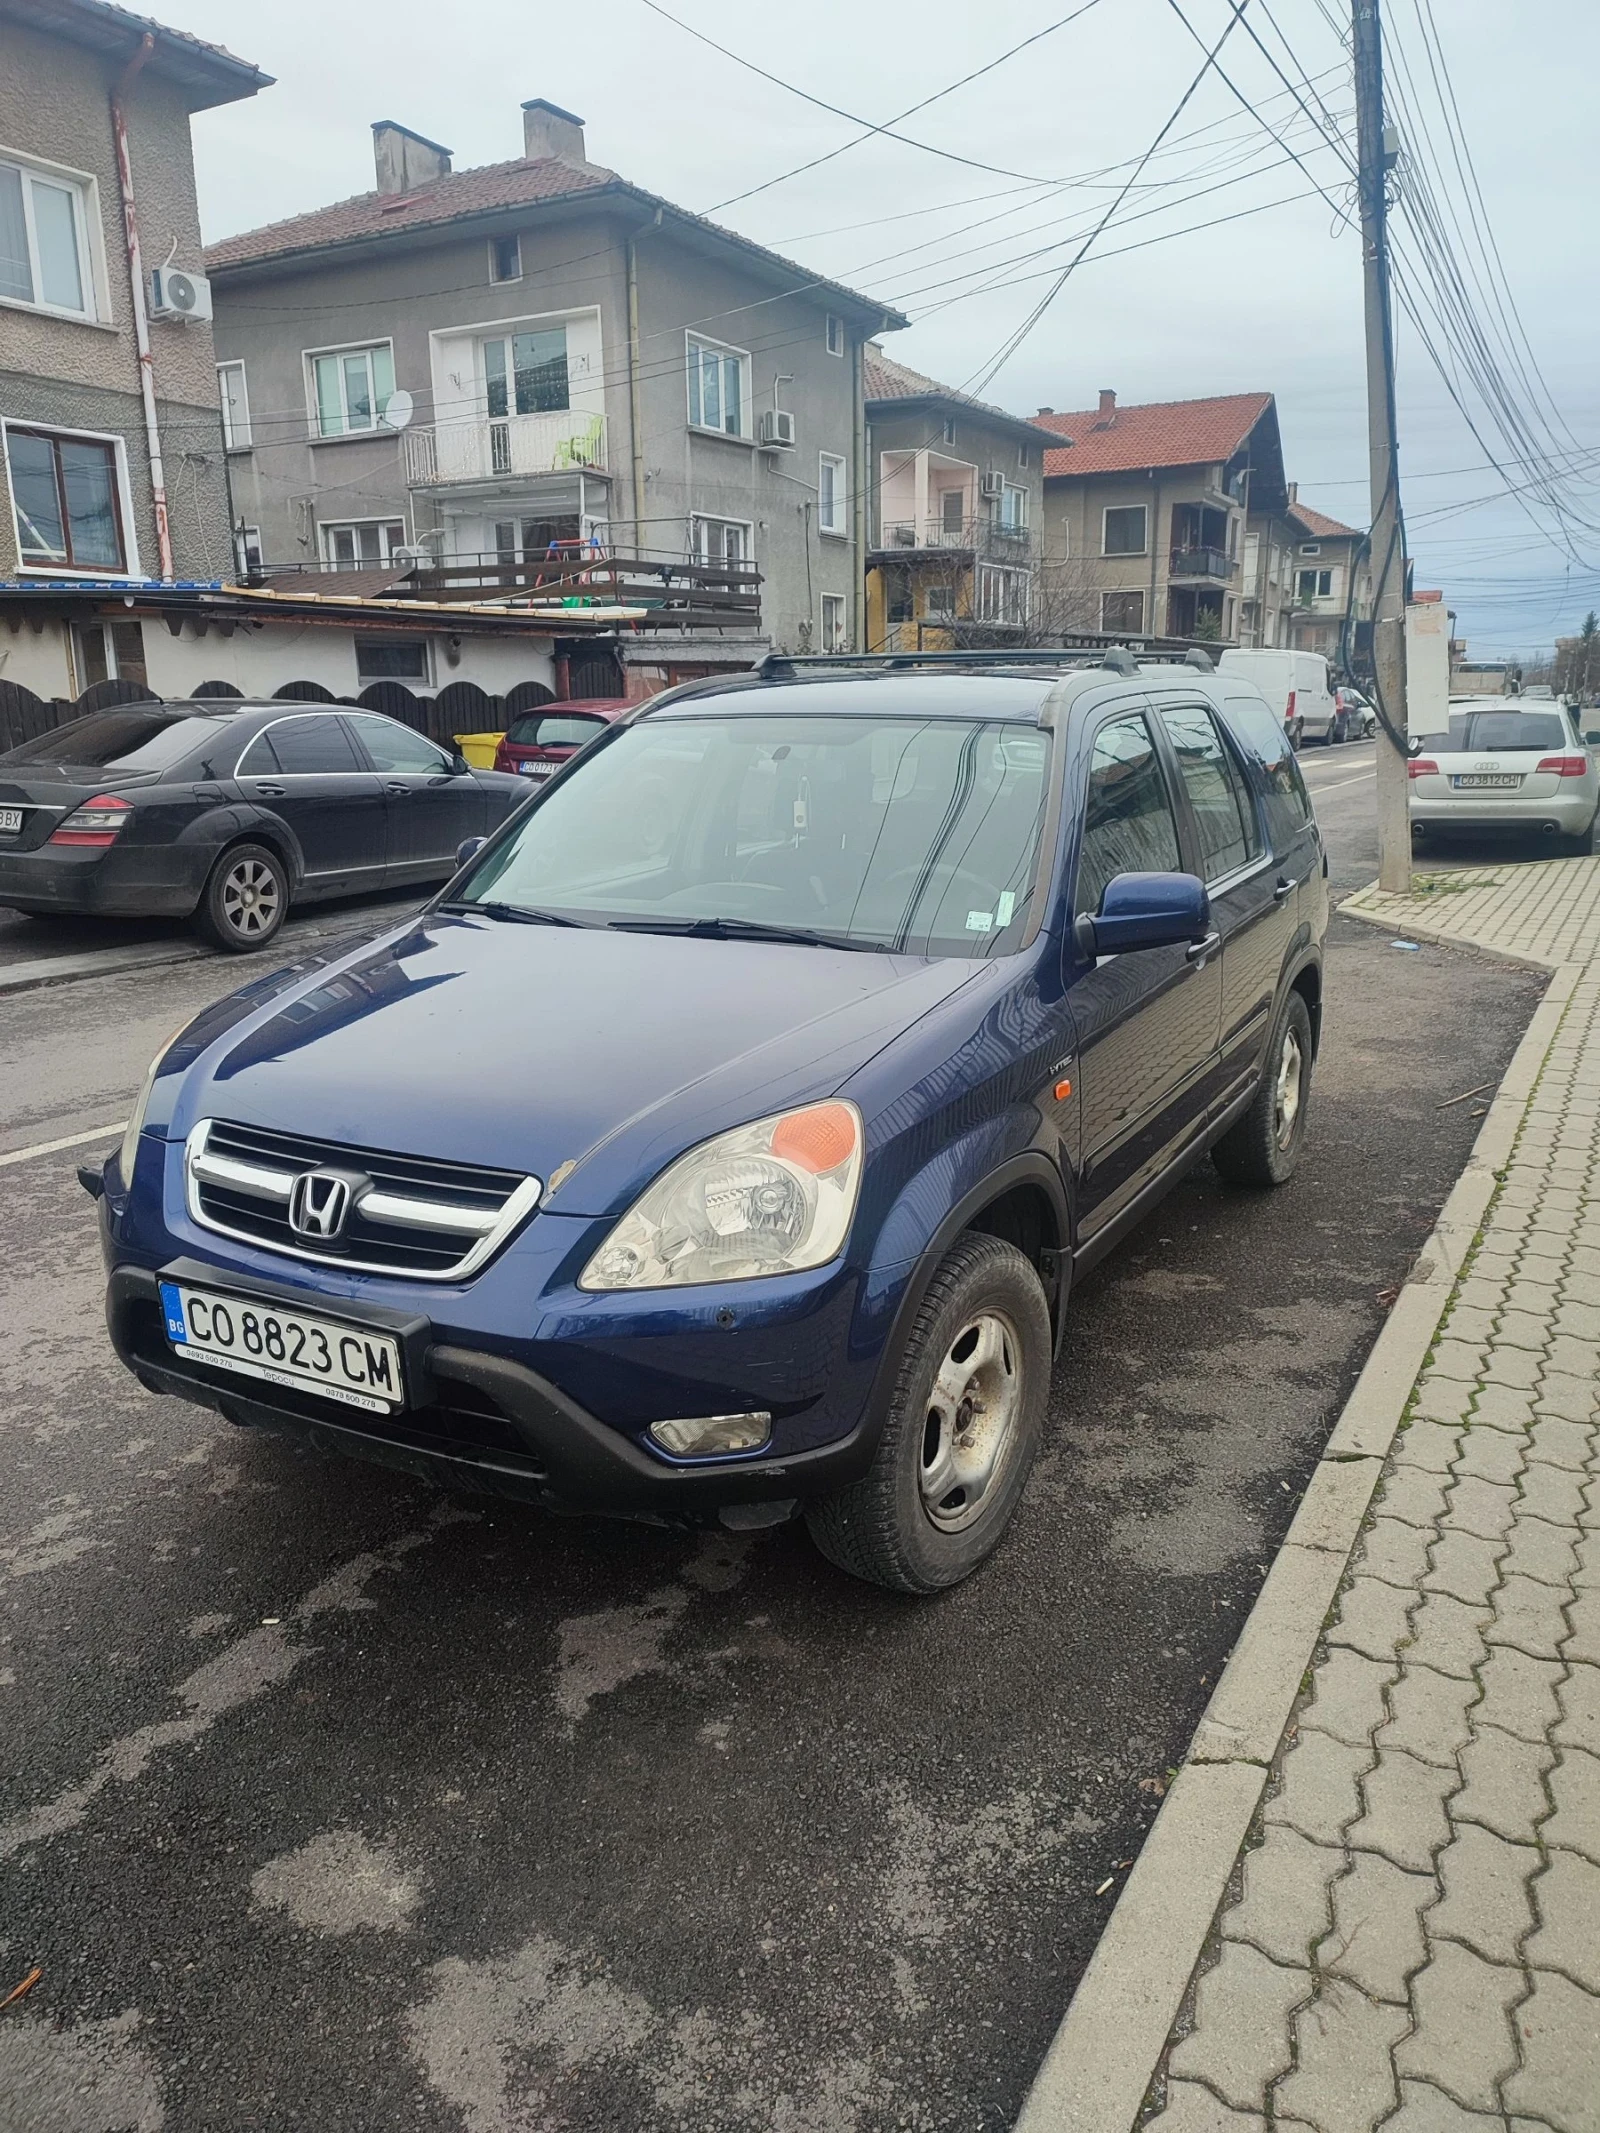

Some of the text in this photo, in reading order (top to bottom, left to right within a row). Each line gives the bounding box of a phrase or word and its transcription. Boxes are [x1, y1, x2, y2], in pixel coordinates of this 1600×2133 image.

[168, 1319, 184, 1334] BG
[242, 1311, 332, 1373] 8823
[340, 1336, 392, 1392] CM
